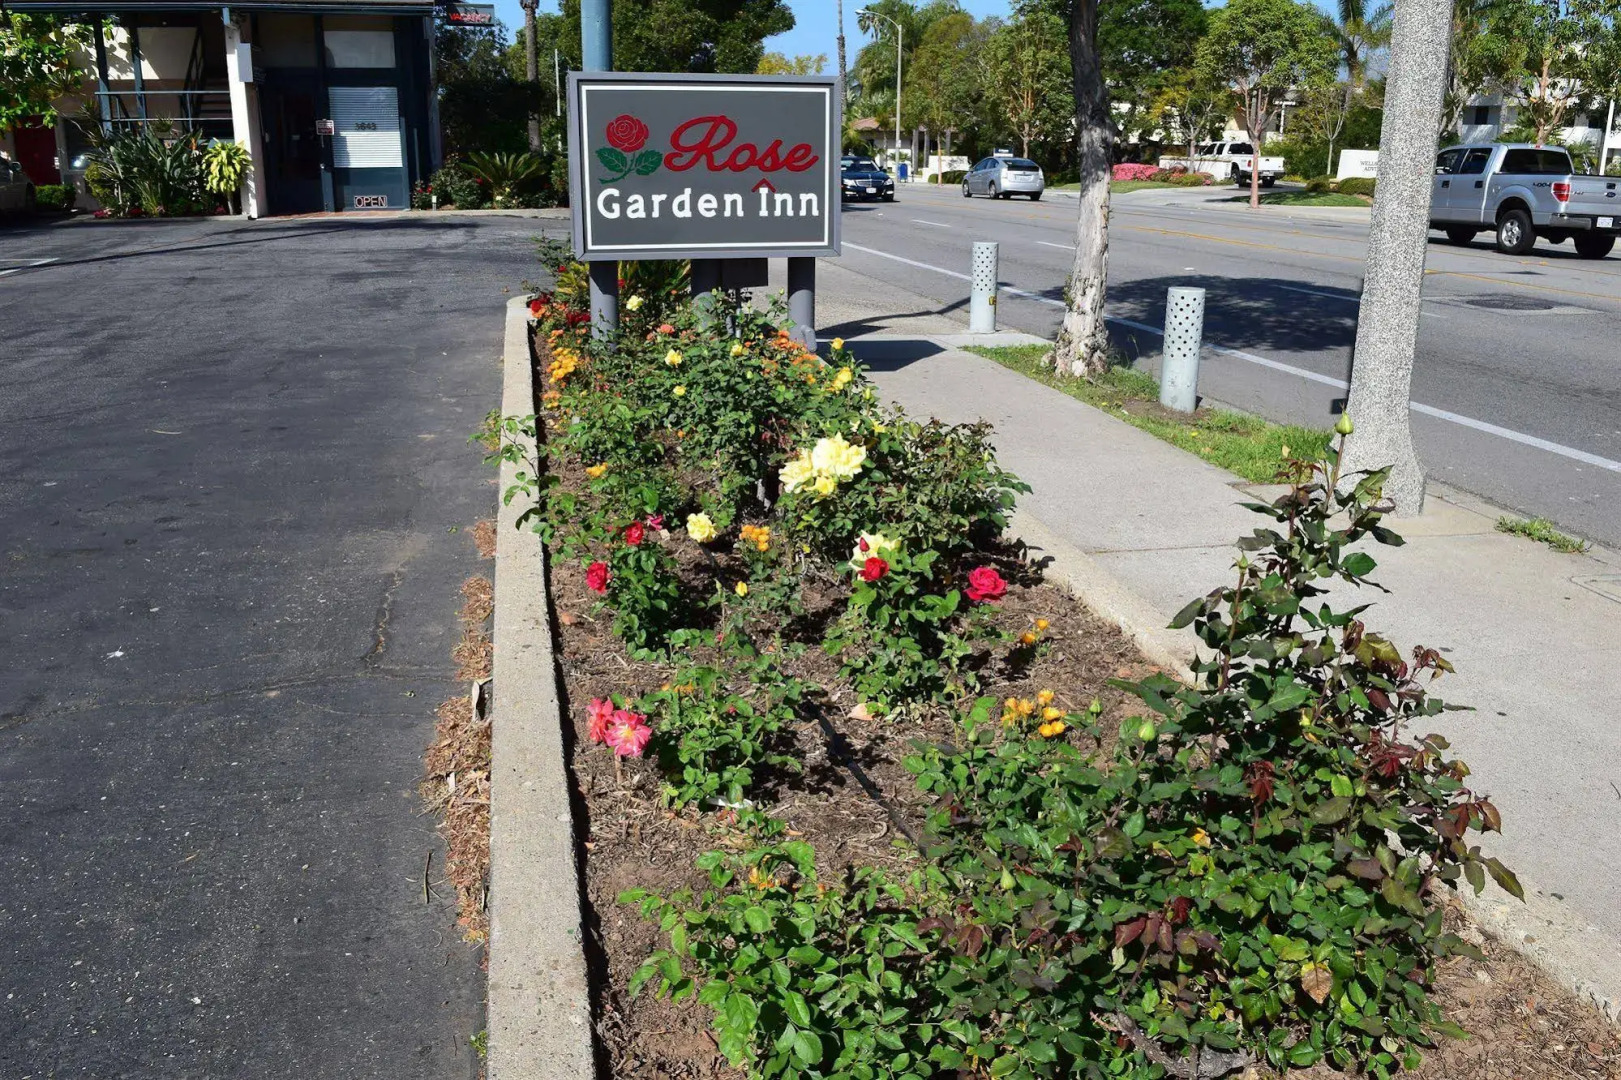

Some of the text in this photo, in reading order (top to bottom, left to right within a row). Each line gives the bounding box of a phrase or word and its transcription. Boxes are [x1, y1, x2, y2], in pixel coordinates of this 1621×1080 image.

[664, 115, 819, 172] Rose
[356, 196, 386, 207] OPEN
[597, 187, 819, 219] Garden Inn
